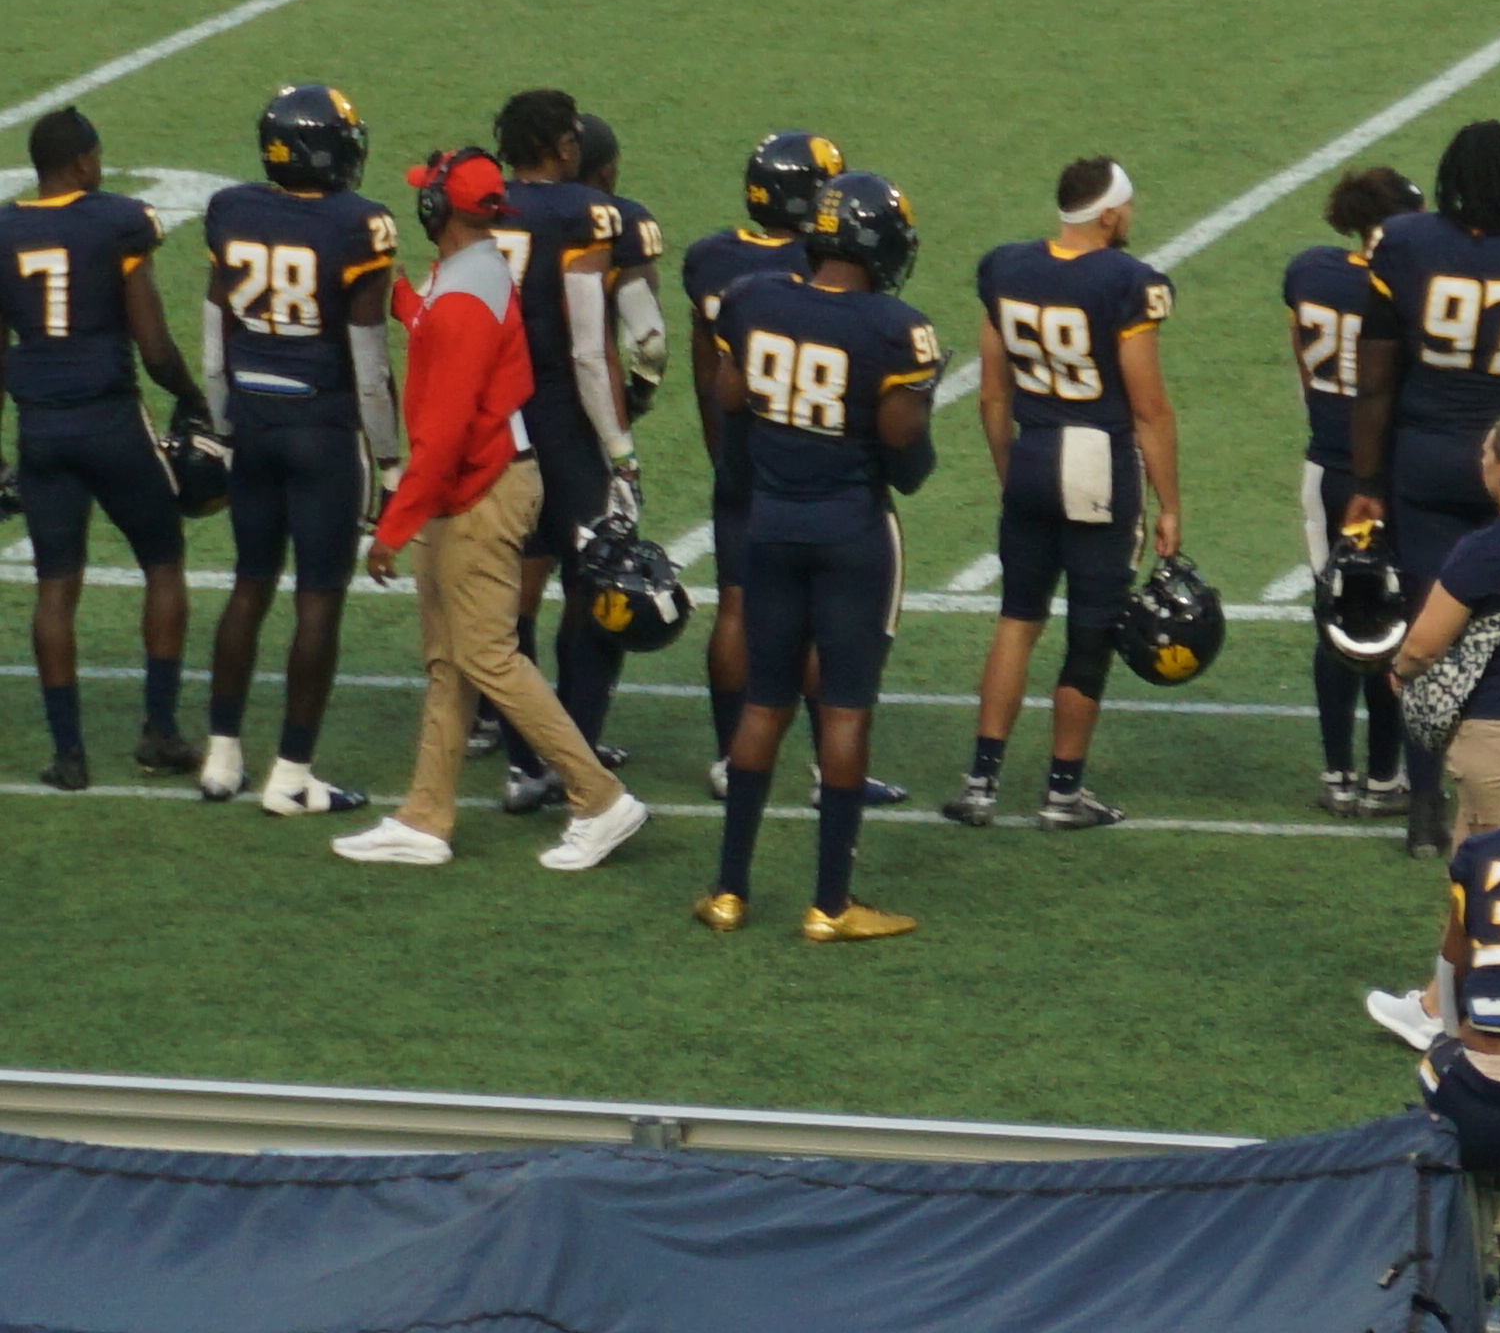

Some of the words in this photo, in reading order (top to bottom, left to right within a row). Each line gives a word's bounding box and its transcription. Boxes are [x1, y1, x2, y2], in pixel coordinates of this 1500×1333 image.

[224, 240, 323, 337] 28
[493, 229, 533, 288] 7
[746, 330, 850, 437] 98
[998, 299, 1104, 401] 58
